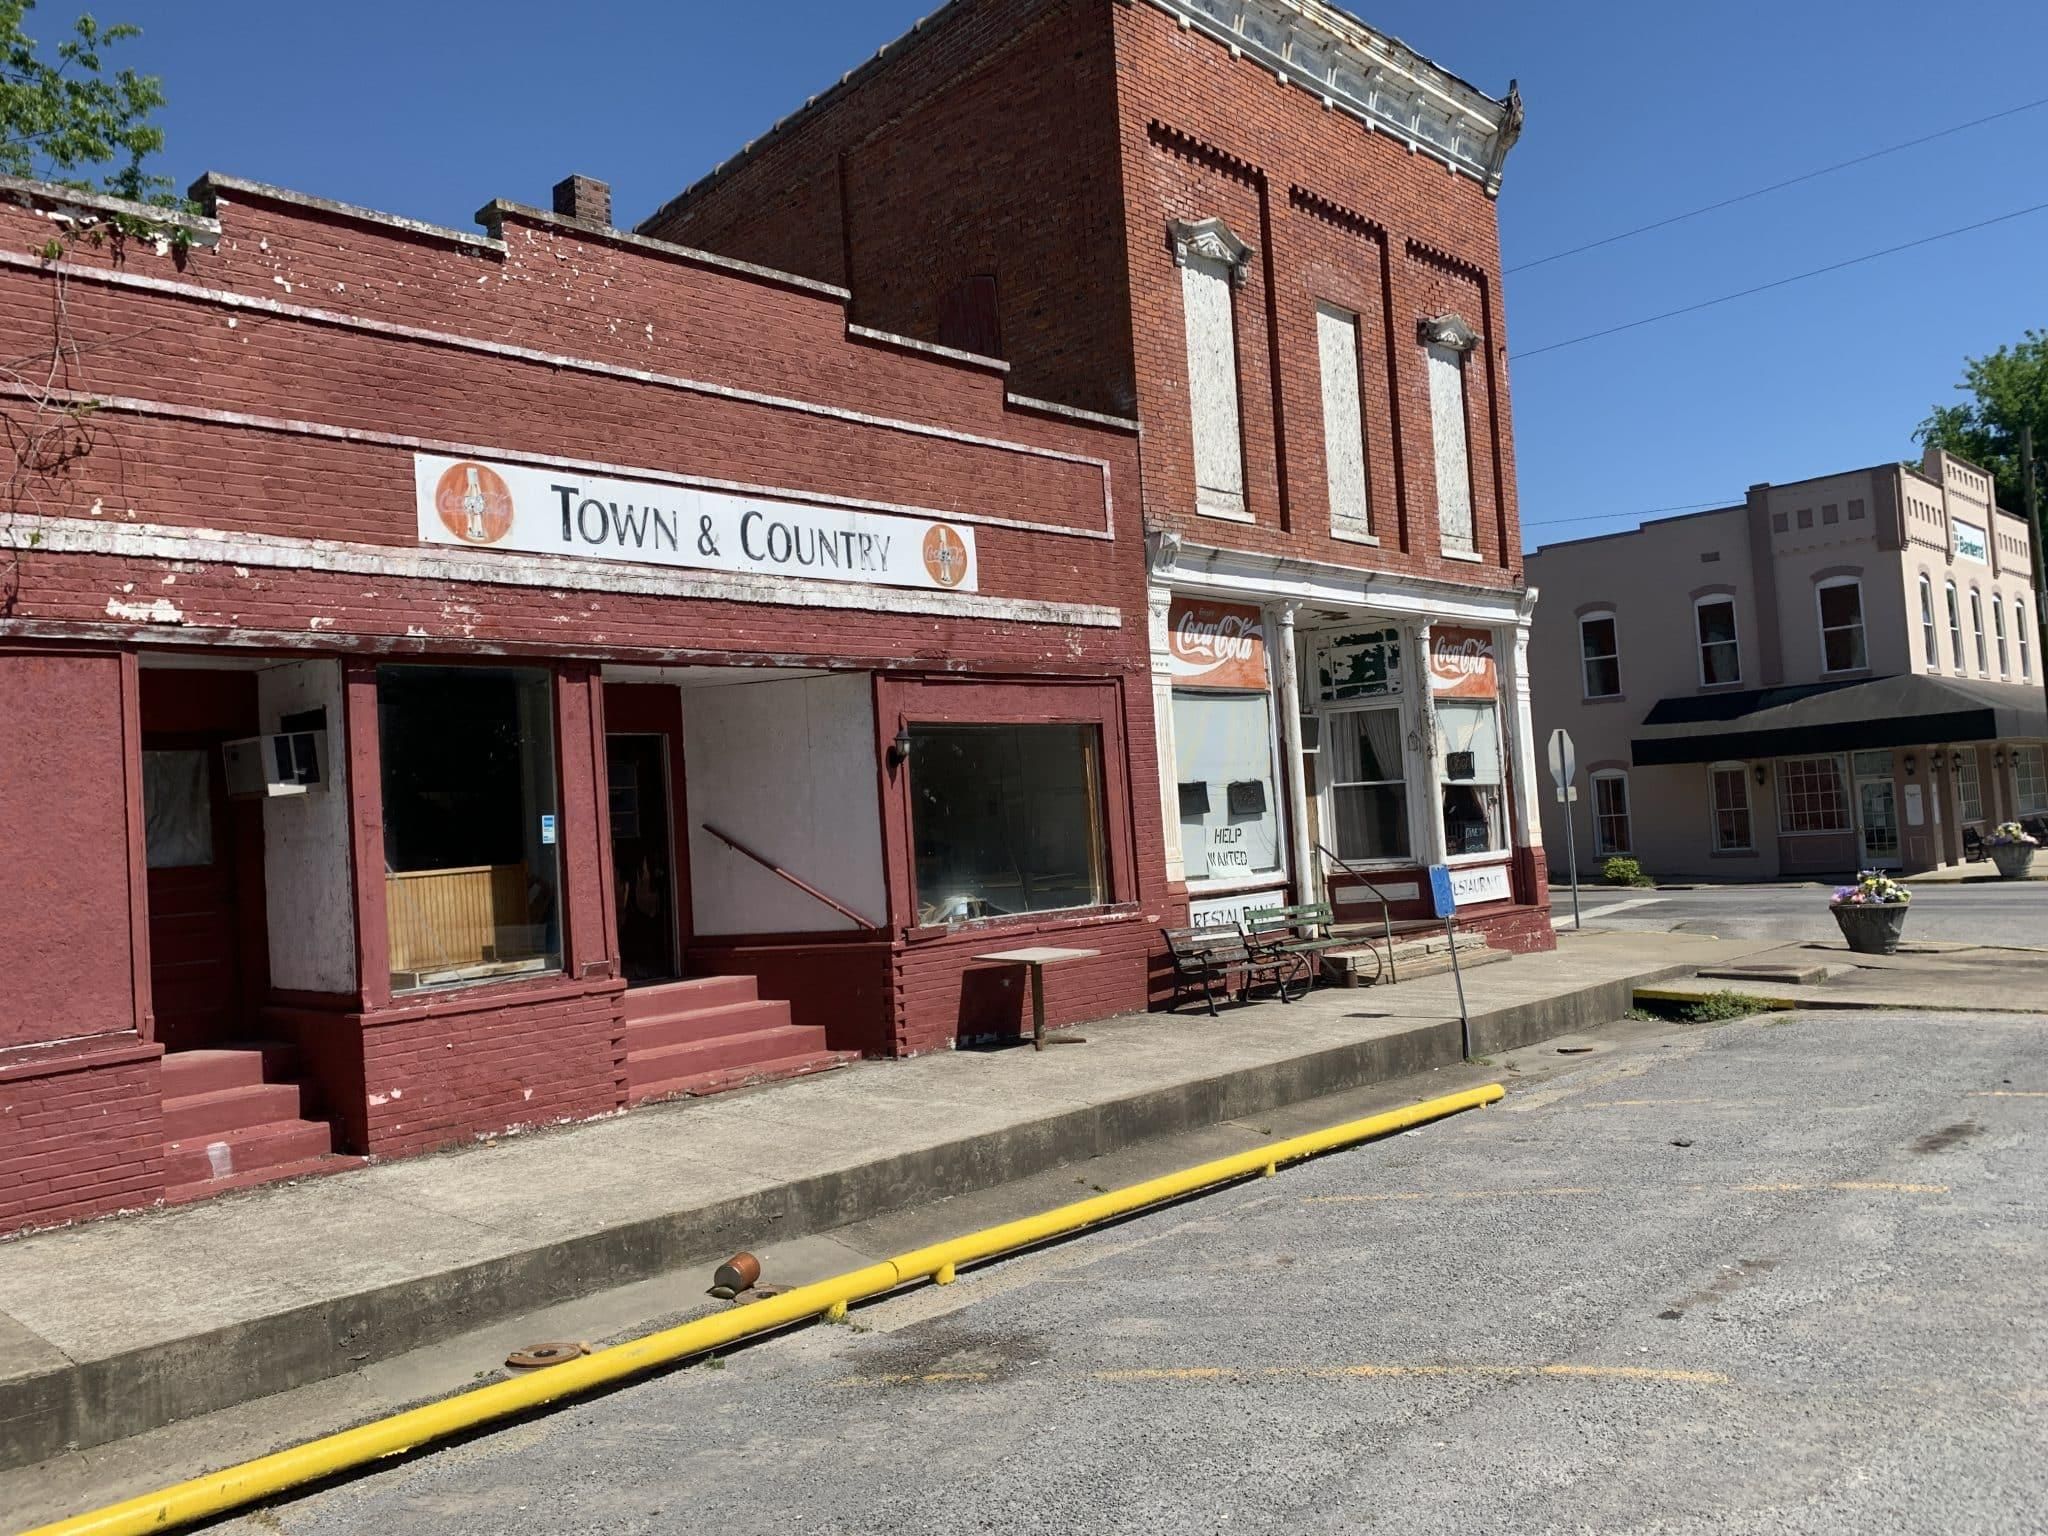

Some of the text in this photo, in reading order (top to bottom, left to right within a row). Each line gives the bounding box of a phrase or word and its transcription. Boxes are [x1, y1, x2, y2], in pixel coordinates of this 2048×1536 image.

[550, 484, 891, 572] TOWN & COUNTRY
[1177, 610, 1258, 660] Coca-Cola
[1214, 827, 1242, 844] HELP
[1207, 850, 1248, 867] WANTED
